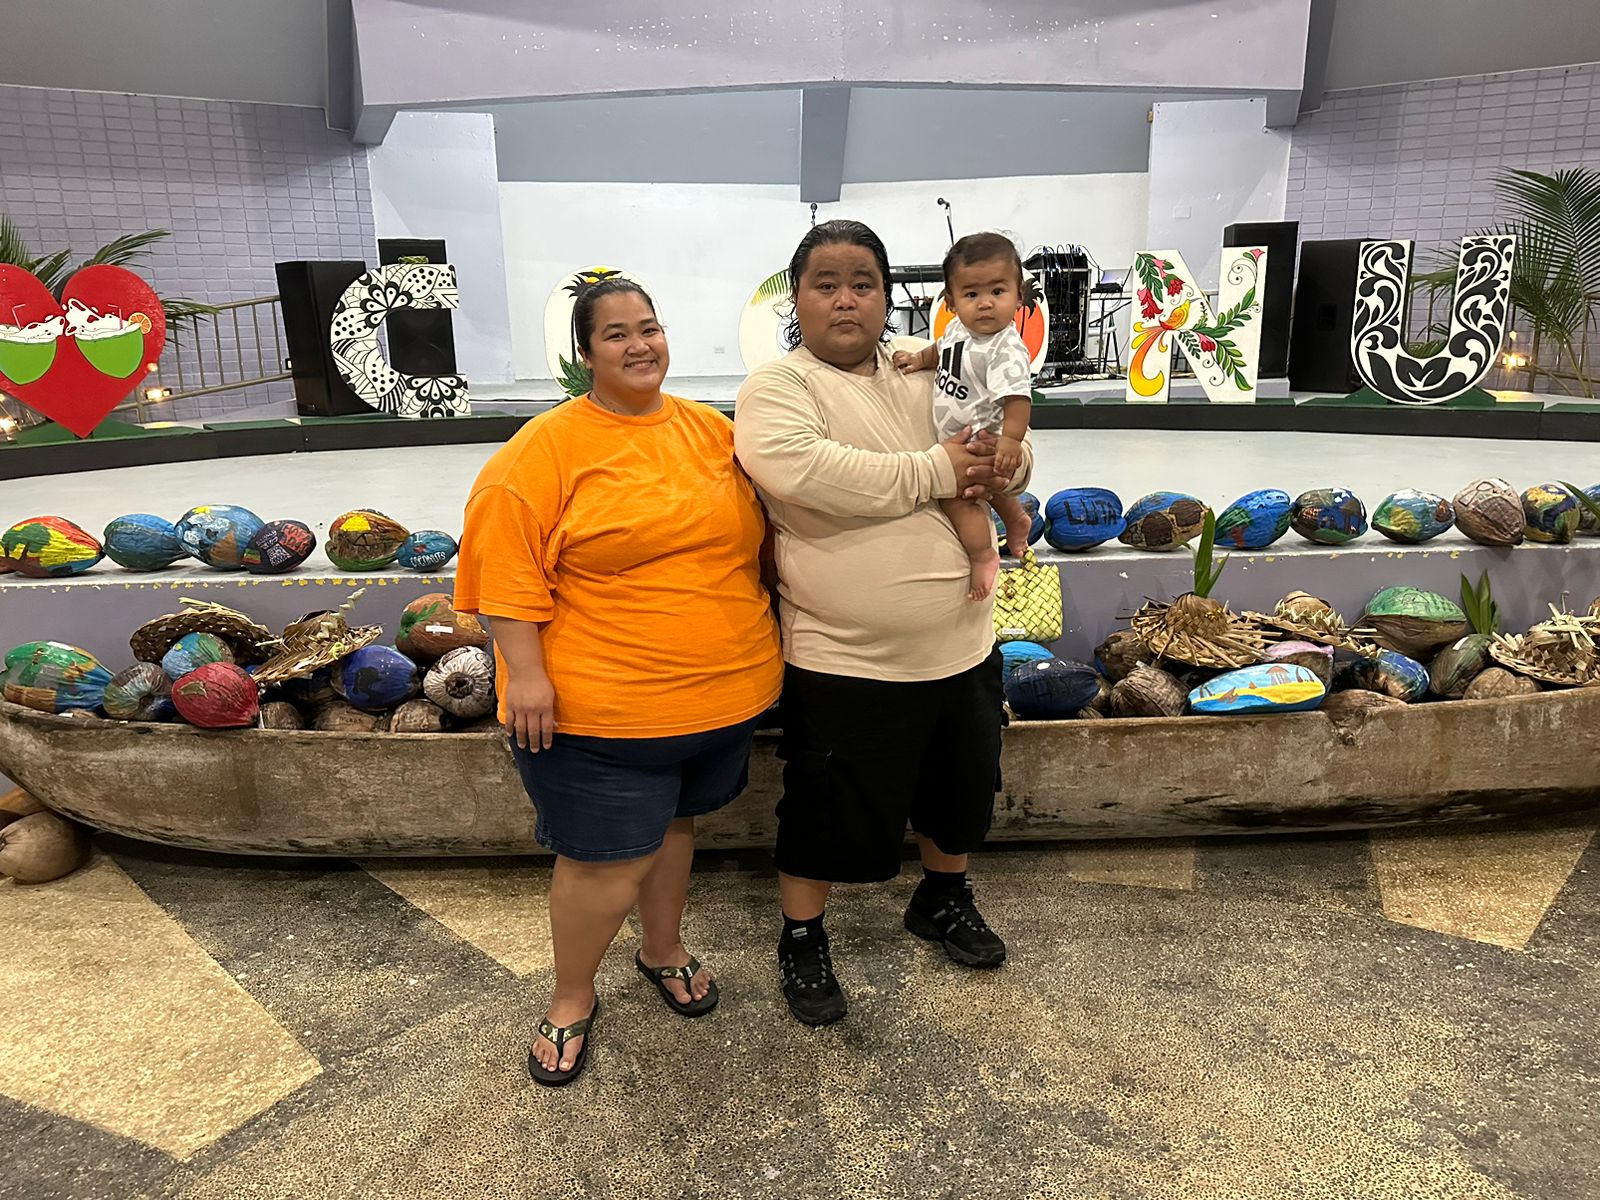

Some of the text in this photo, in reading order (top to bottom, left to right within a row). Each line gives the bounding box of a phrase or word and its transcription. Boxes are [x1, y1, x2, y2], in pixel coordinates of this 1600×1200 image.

[935, 366, 969, 400] idas
[1063, 498, 1118, 525] LUTA
[414, 533, 423, 543] I
